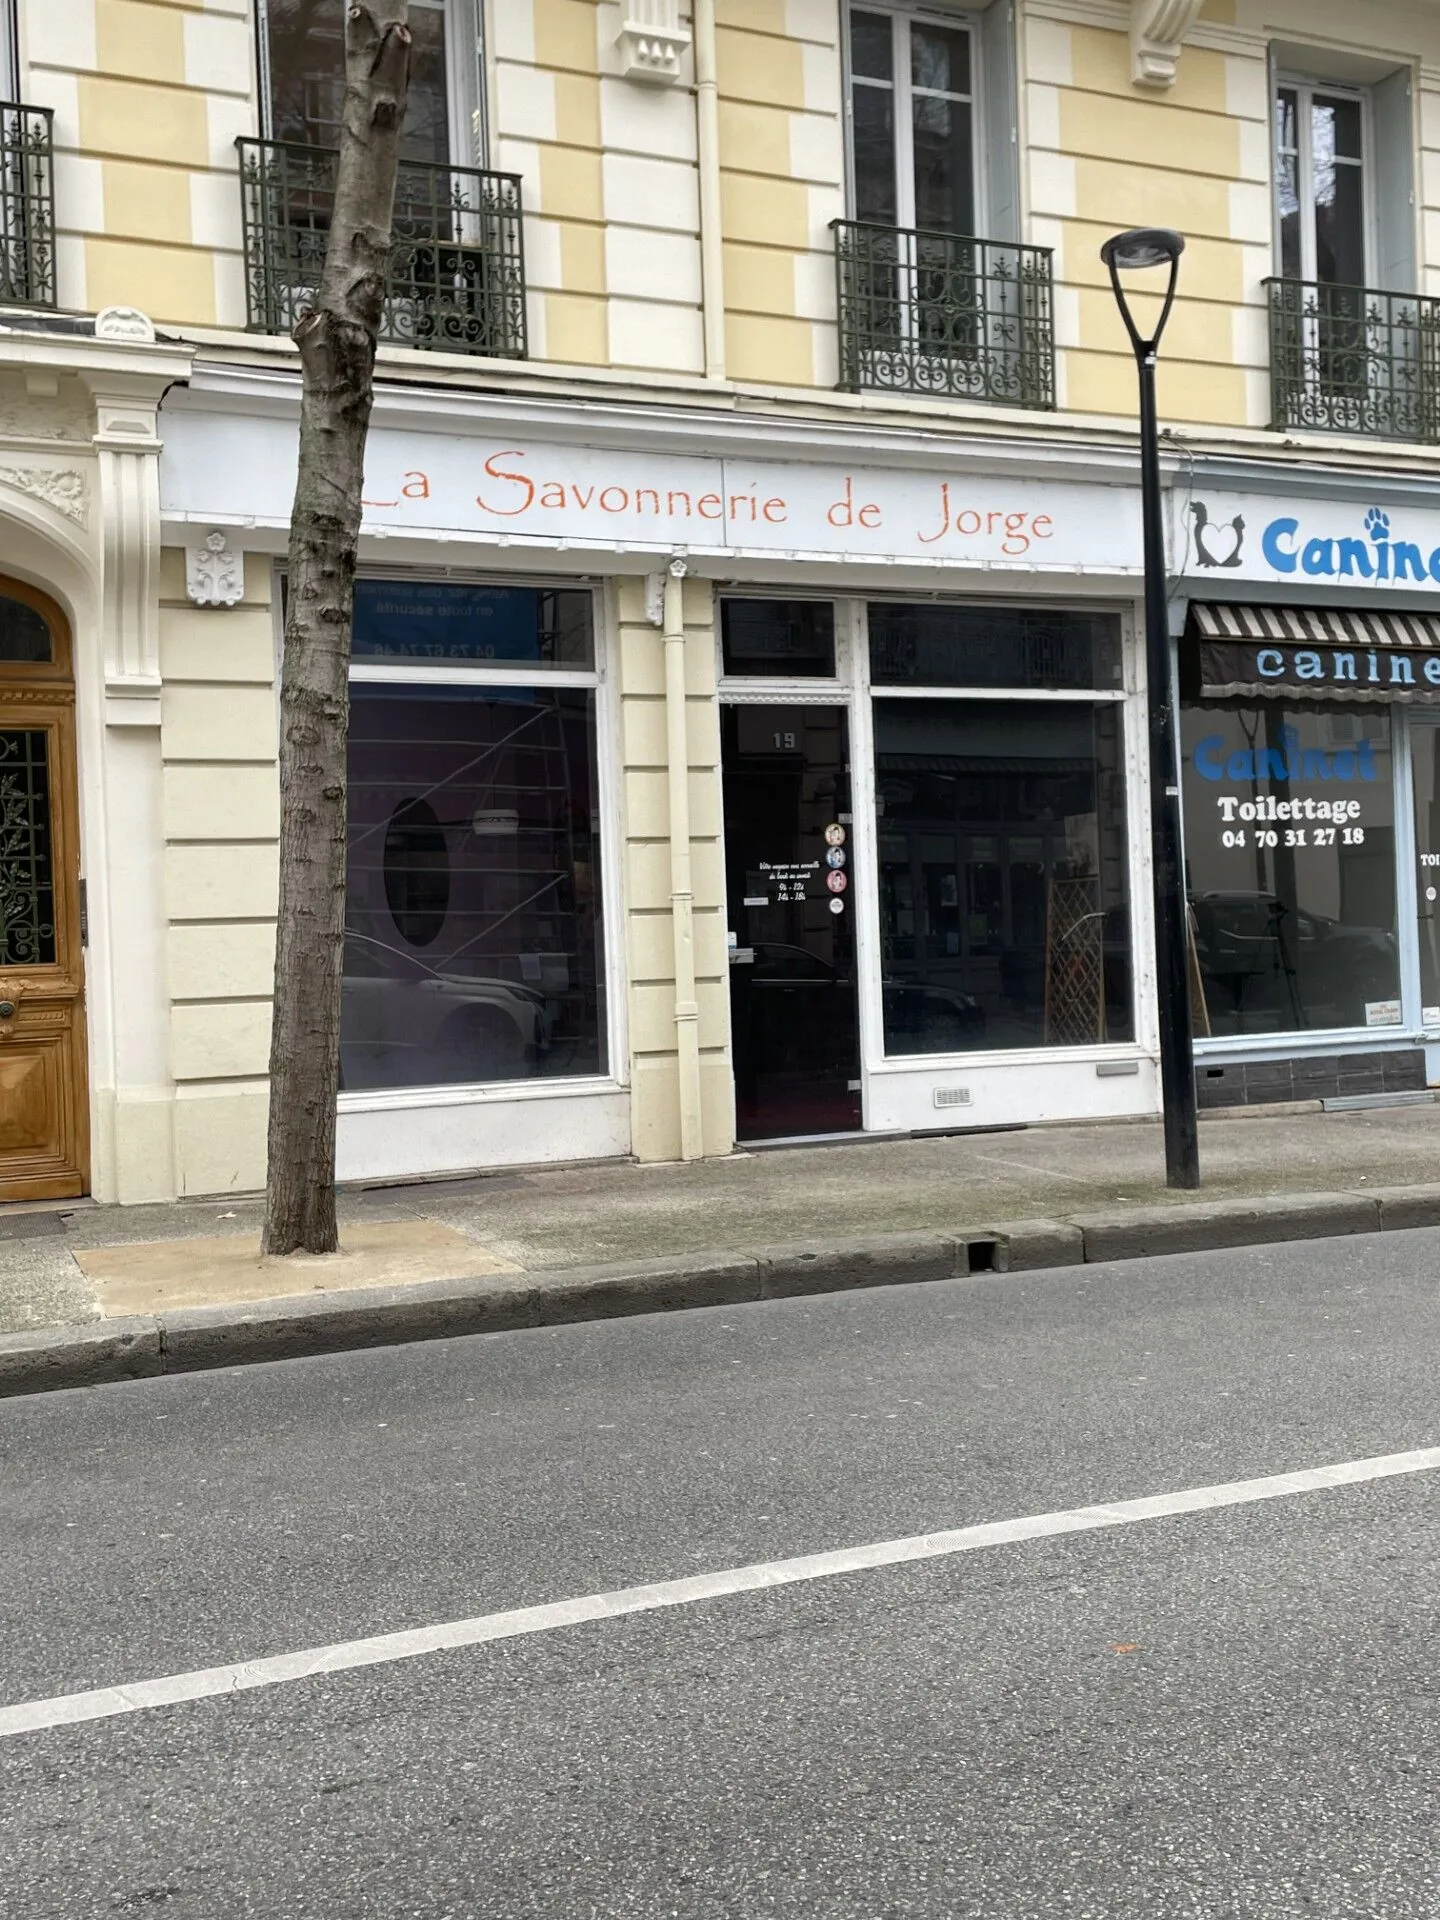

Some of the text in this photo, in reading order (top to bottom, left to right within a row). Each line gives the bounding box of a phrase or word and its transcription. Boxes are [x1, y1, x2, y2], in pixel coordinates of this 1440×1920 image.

[477, 451, 788, 523] Savonnerie
[827, 477, 882, 529] de
[918, 482, 1054, 555] Jorge
[773, 732, 795, 748] 19
[1194, 724, 1377, 781] Caninet
[1217, 795, 1361, 824] Toilettage
[1222, 827, 1365, 848] 04 70 31 27 18
